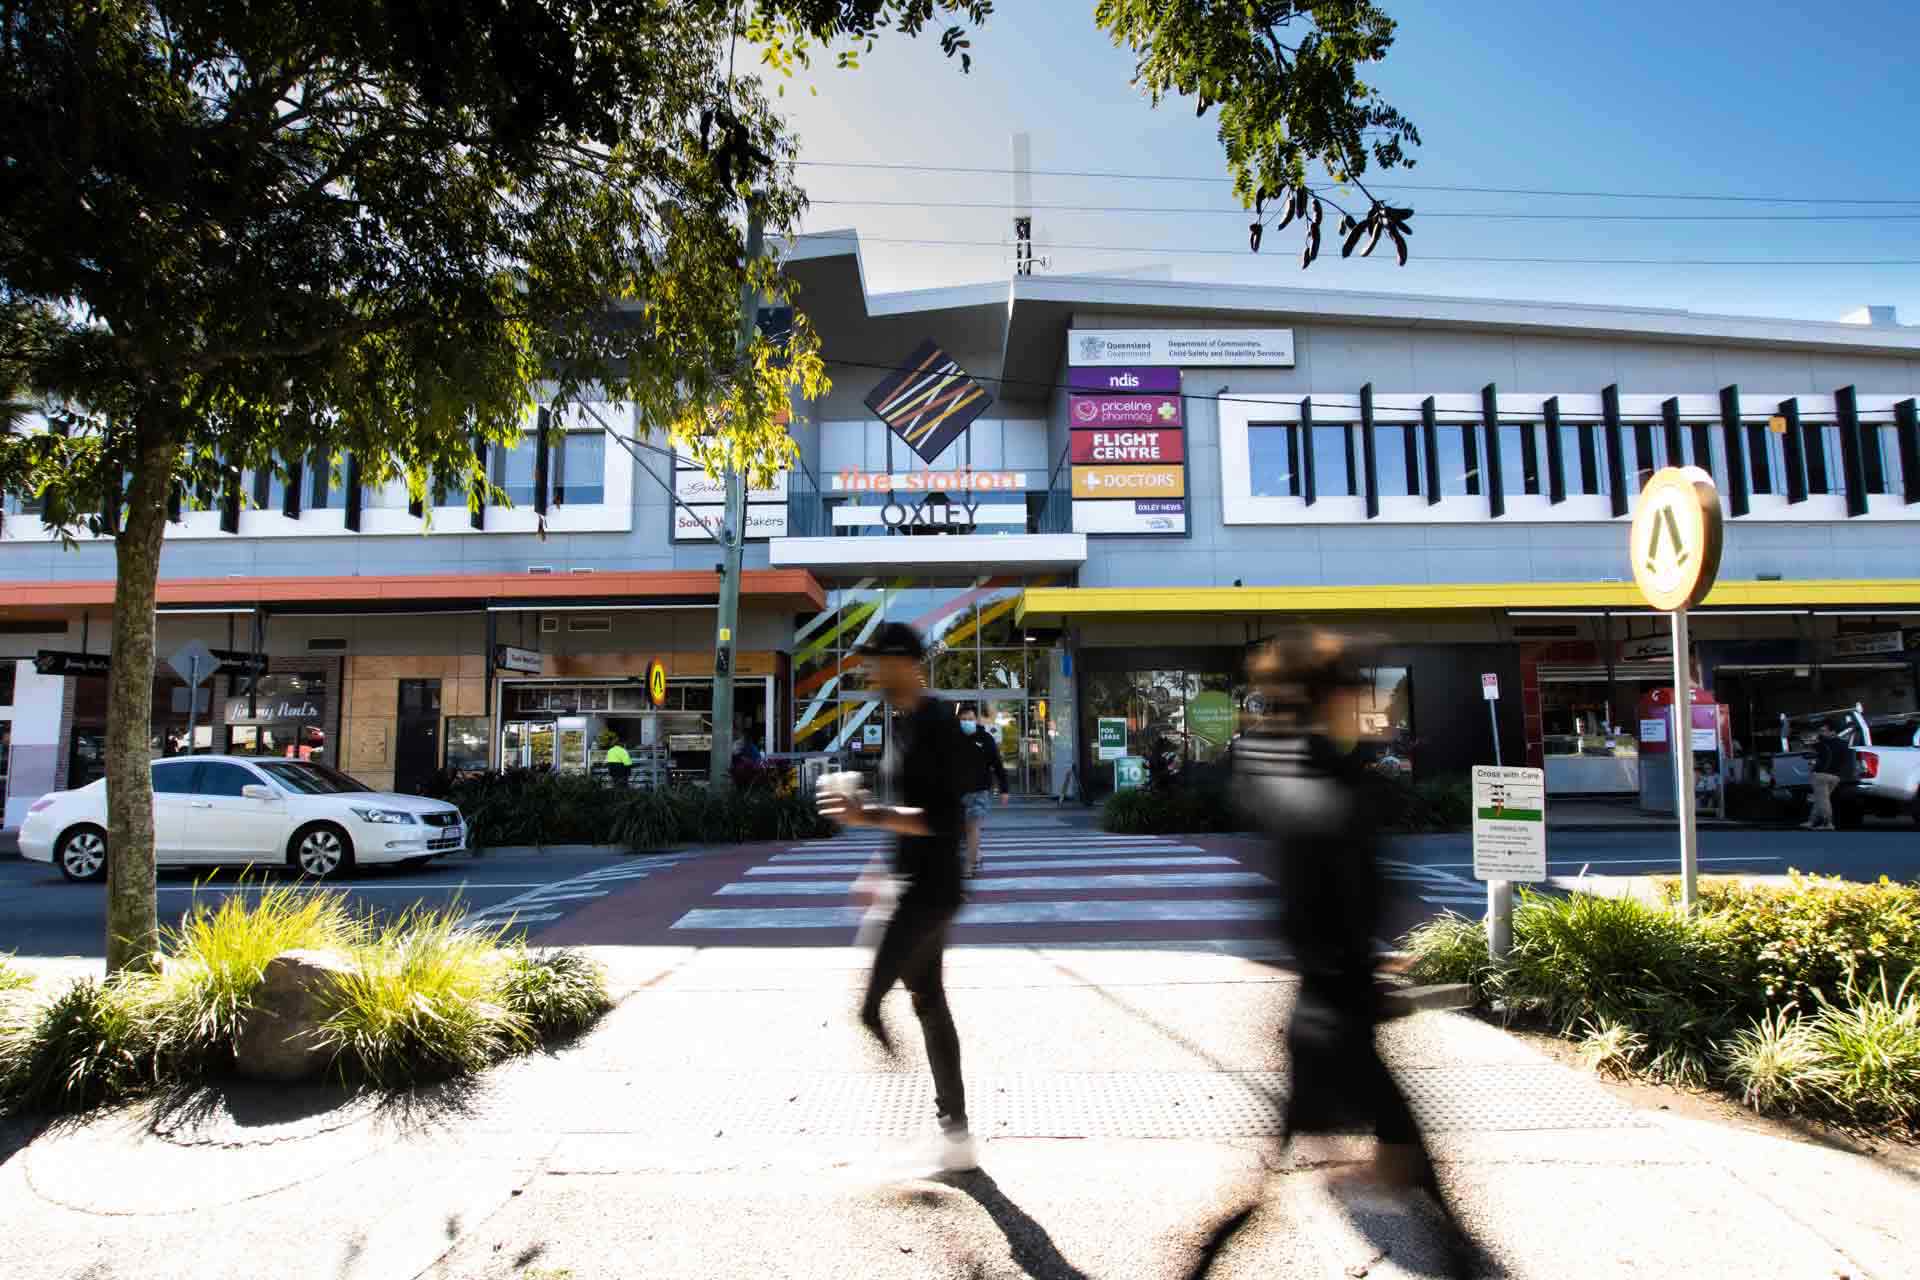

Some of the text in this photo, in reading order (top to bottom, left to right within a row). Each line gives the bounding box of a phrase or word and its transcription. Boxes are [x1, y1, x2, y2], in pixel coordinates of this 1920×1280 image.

[1168, 340, 1207, 348] Department
[1187, 350, 1209, 358] Safety
[1225, 350, 1255, 358] Disability
[1109, 372, 1139, 387] ndis
[1102, 400, 1152, 413] priceline
[1102, 412, 1152, 423] pharmacy
[1093, 433, 1159, 446] FLIGHT
[1093, 447, 1160, 459] CENTRE
[839, 465, 1017, 492] the station
[1104, 474, 1175, 487] DOCTORS
[679, 515, 711, 528] South
[745, 516, 785, 526] Bakers
[881, 503, 978, 527] OXLEY
[1477, 769, 1500, 777] Cross
